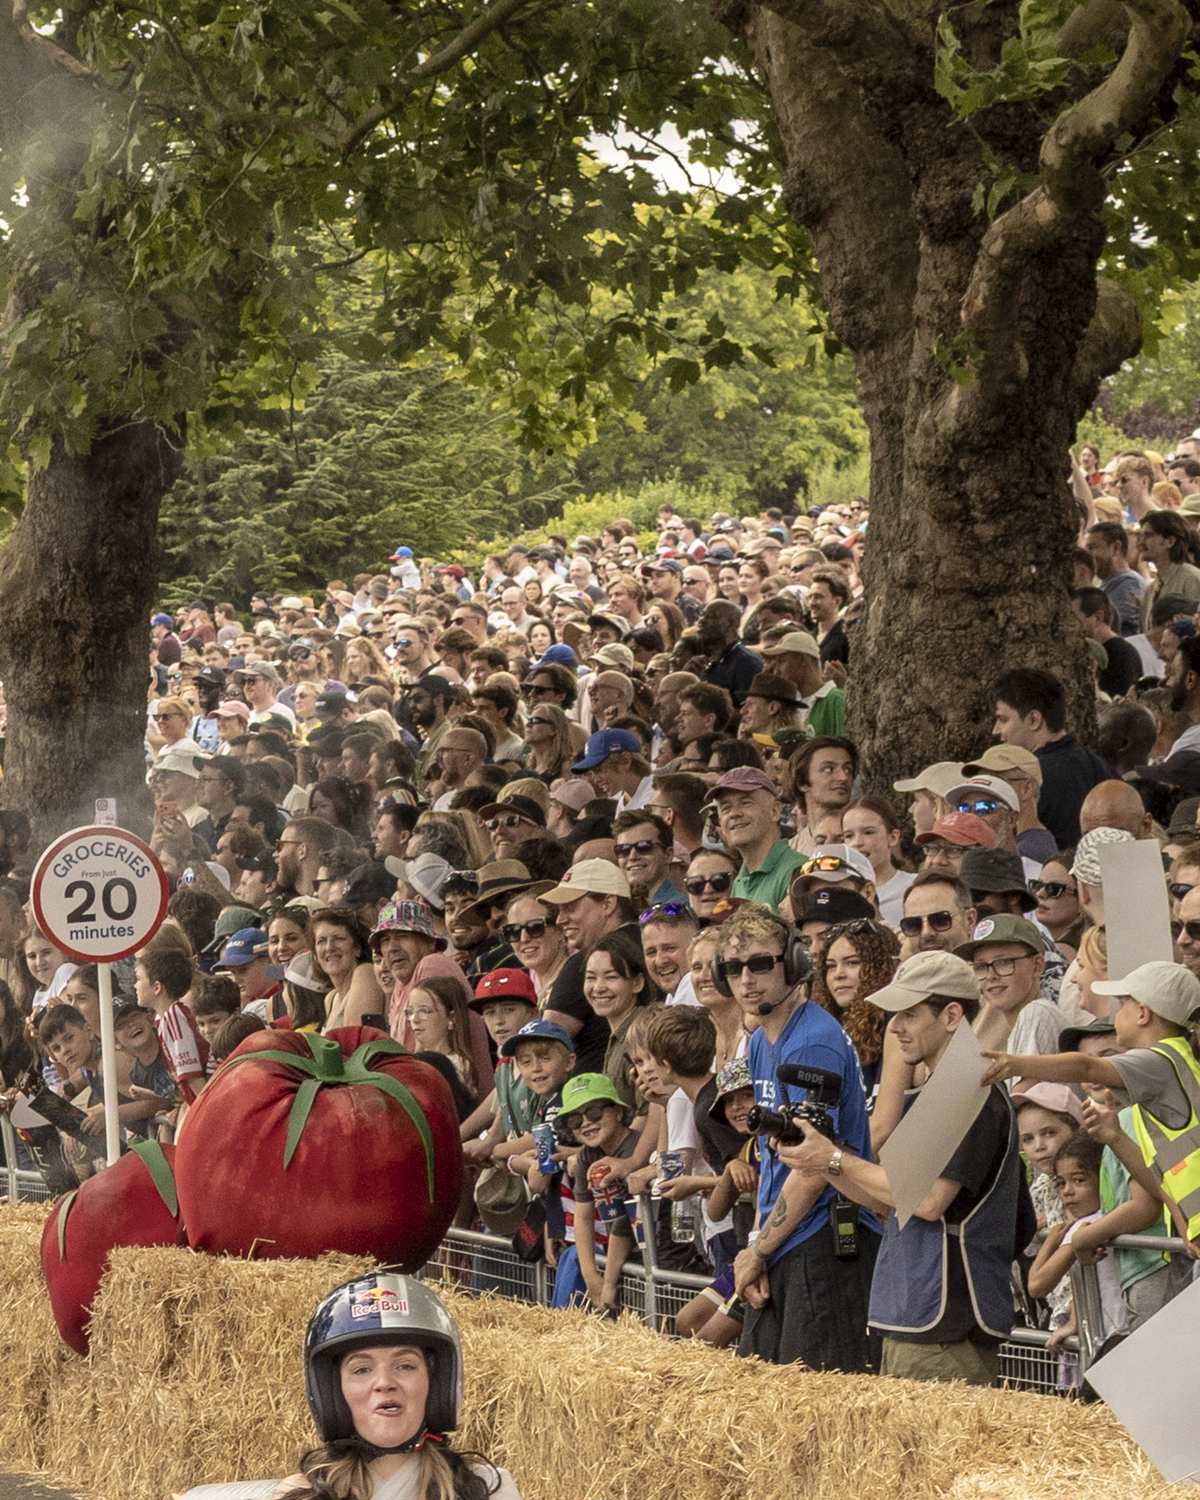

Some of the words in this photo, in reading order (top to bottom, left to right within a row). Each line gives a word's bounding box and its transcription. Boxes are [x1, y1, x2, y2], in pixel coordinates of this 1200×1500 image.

[53, 841, 151, 878] GROCERIES
[81, 870, 101, 878] From
[64, 877, 137, 924] 20
[69, 925, 135, 940] minutes
[353, 1302, 379, 1317] Red
[381, 1300, 408, 1312] Bull
